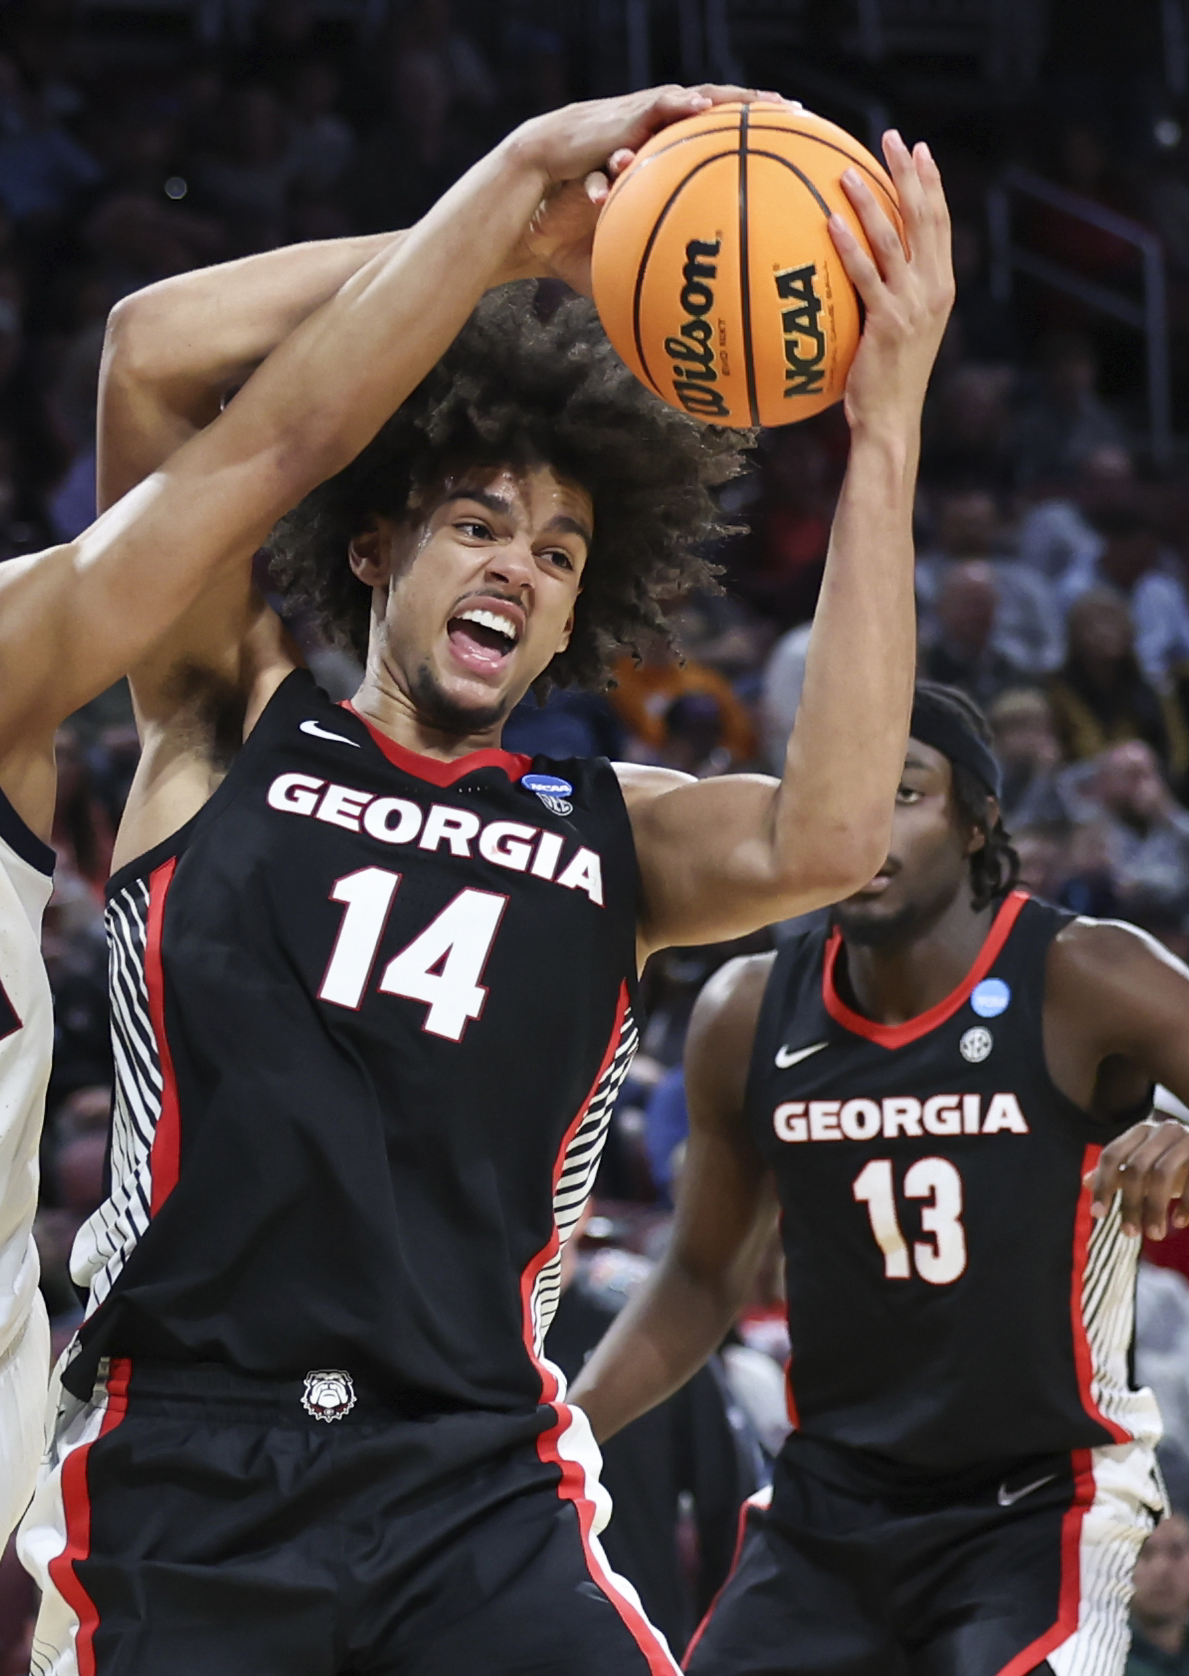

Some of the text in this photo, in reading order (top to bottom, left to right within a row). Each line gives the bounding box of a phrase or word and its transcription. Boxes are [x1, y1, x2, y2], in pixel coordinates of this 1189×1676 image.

[665, 237, 730, 417] Wilson
[775, 260, 827, 400] NCAA
[266, 772, 605, 909] GEORGIA
[530, 782, 571, 793] NCAA
[316, 865, 510, 1044] 14
[772, 1092, 1030, 1143] GEORGIA
[852, 1156, 967, 1285] 13
